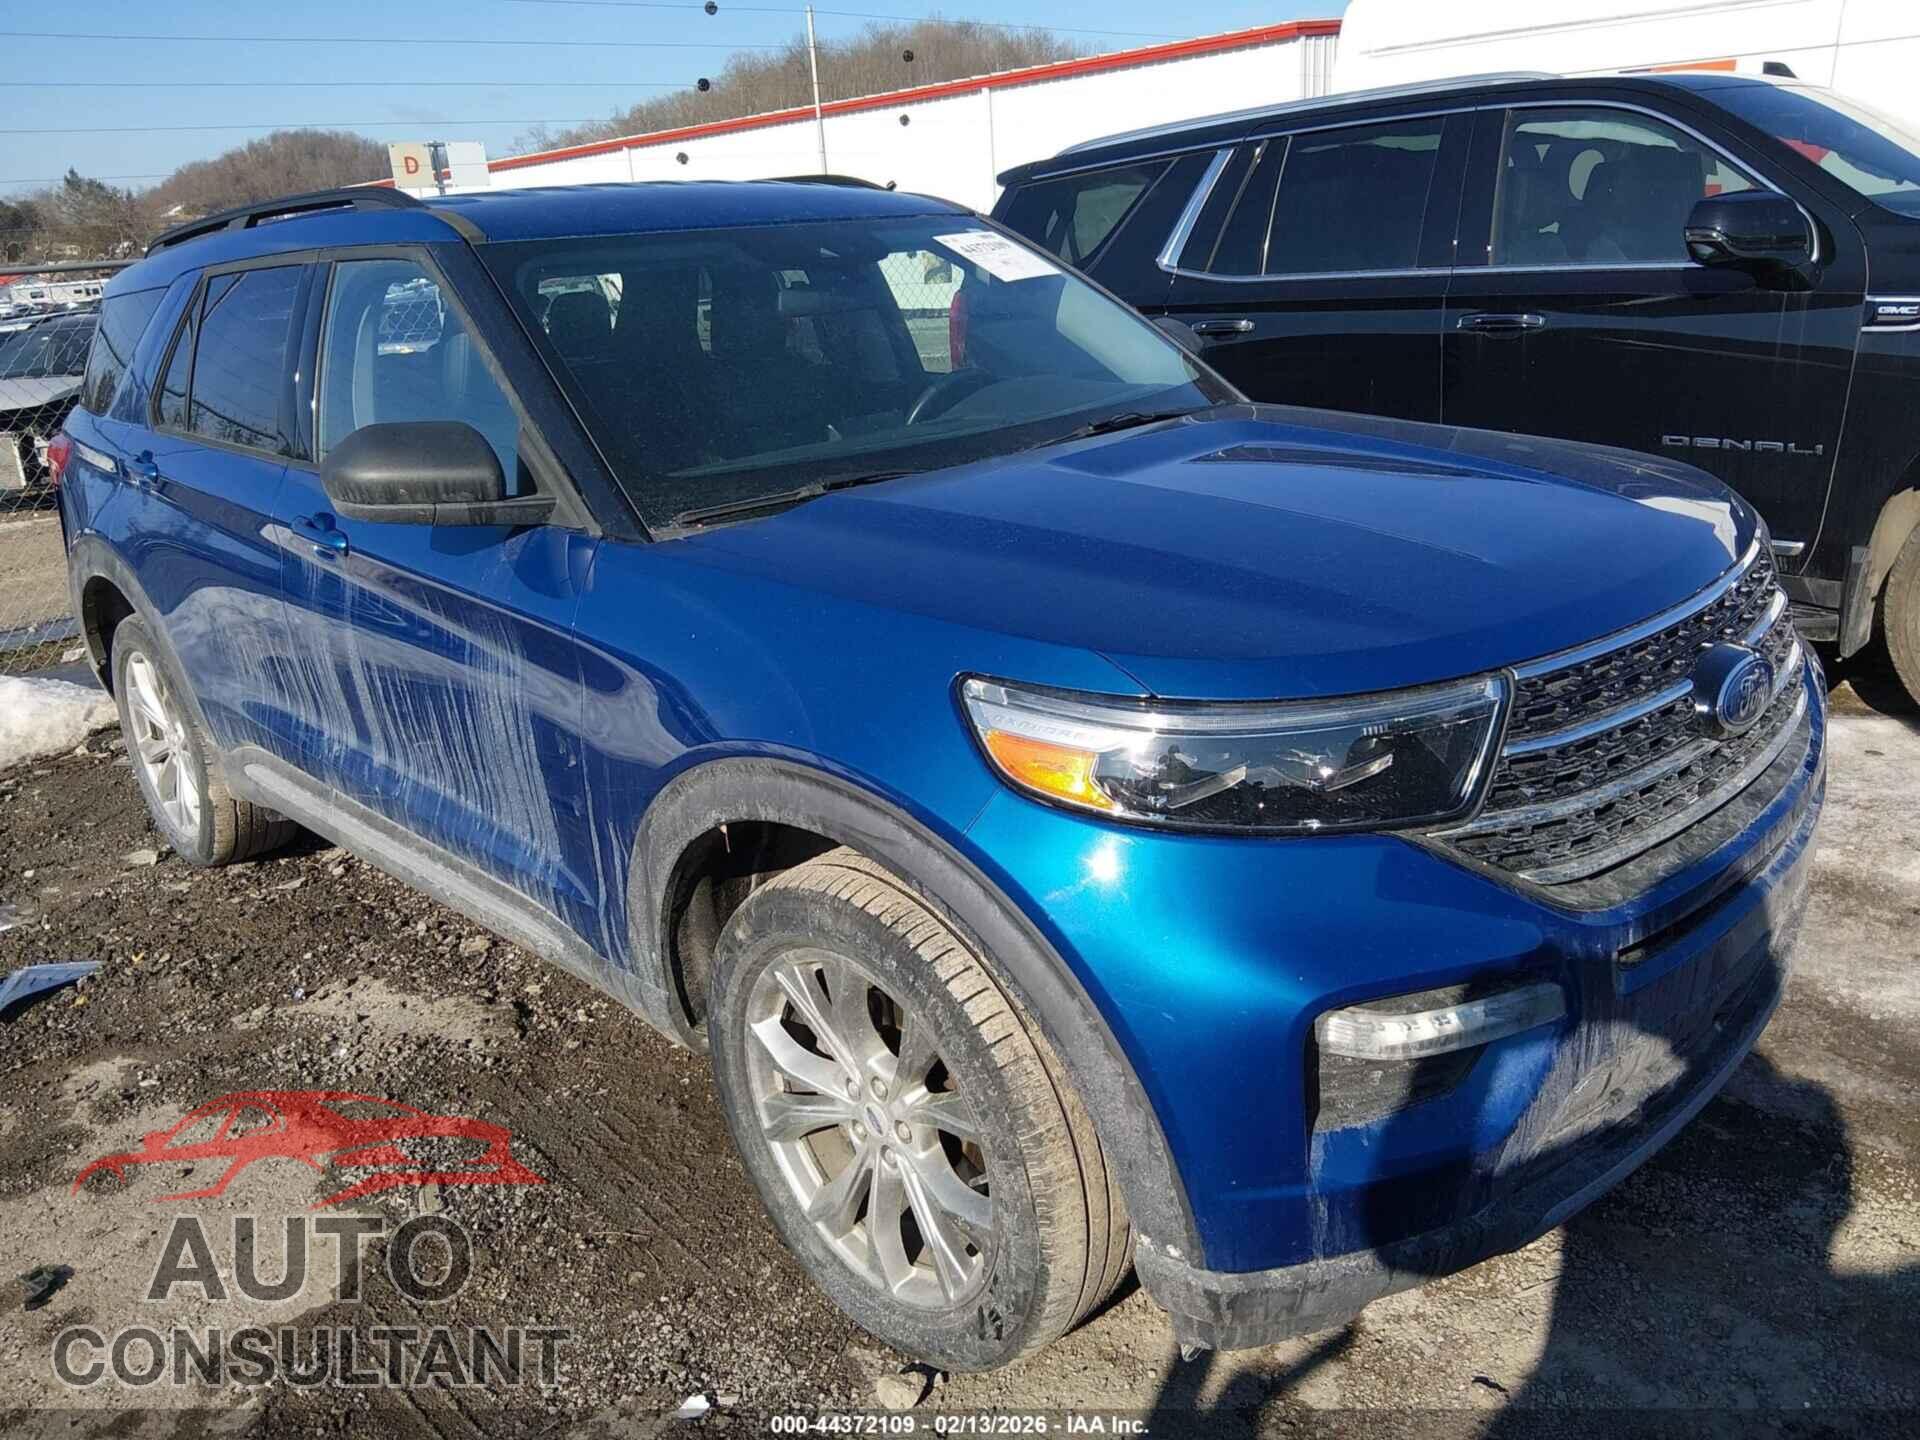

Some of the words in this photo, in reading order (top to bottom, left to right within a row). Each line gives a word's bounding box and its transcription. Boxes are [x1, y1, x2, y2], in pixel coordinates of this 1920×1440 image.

[404, 156, 419, 174] D
[1878, 306, 1919, 314] GMC
[1661, 435, 1824, 456] DENALI
